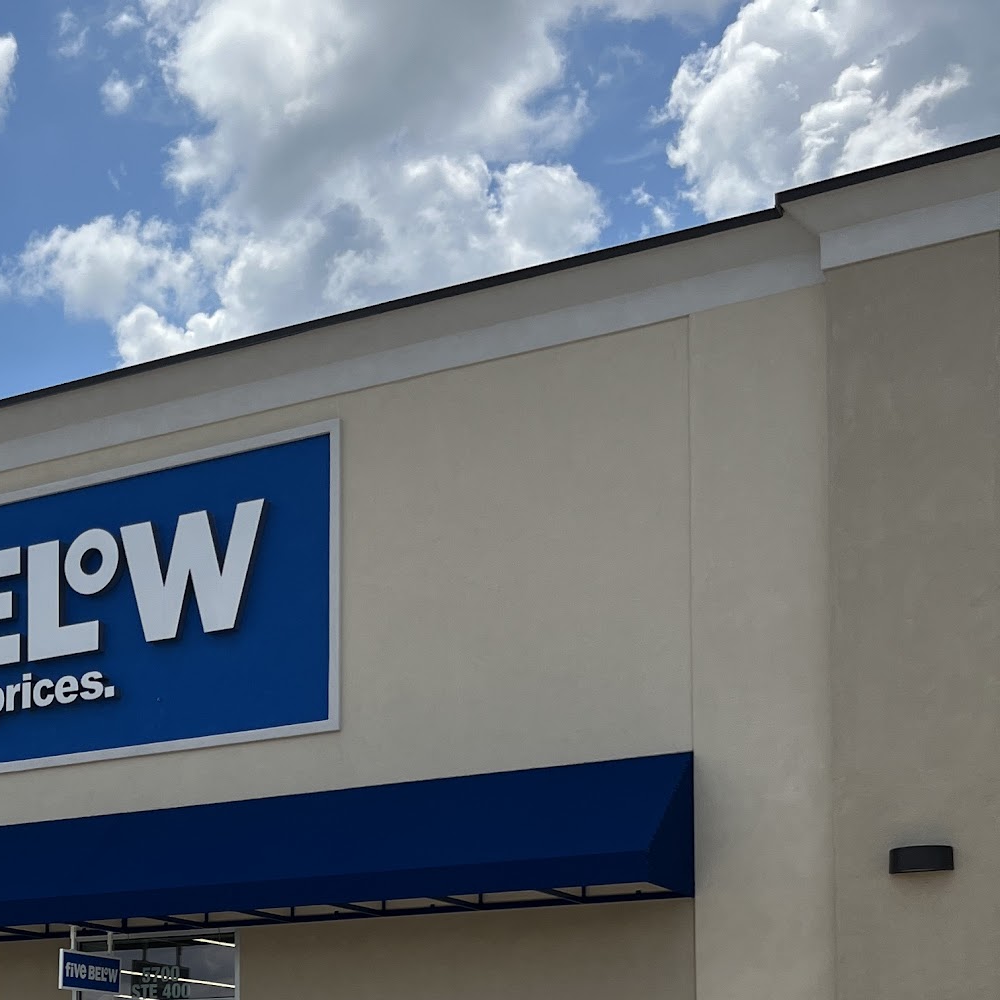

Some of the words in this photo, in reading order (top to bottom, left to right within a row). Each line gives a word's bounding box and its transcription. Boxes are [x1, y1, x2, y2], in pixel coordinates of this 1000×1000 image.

[142, 966, 180, 983] 5700
[131, 984, 158, 999] STE
[162, 983, 191, 999] 400
